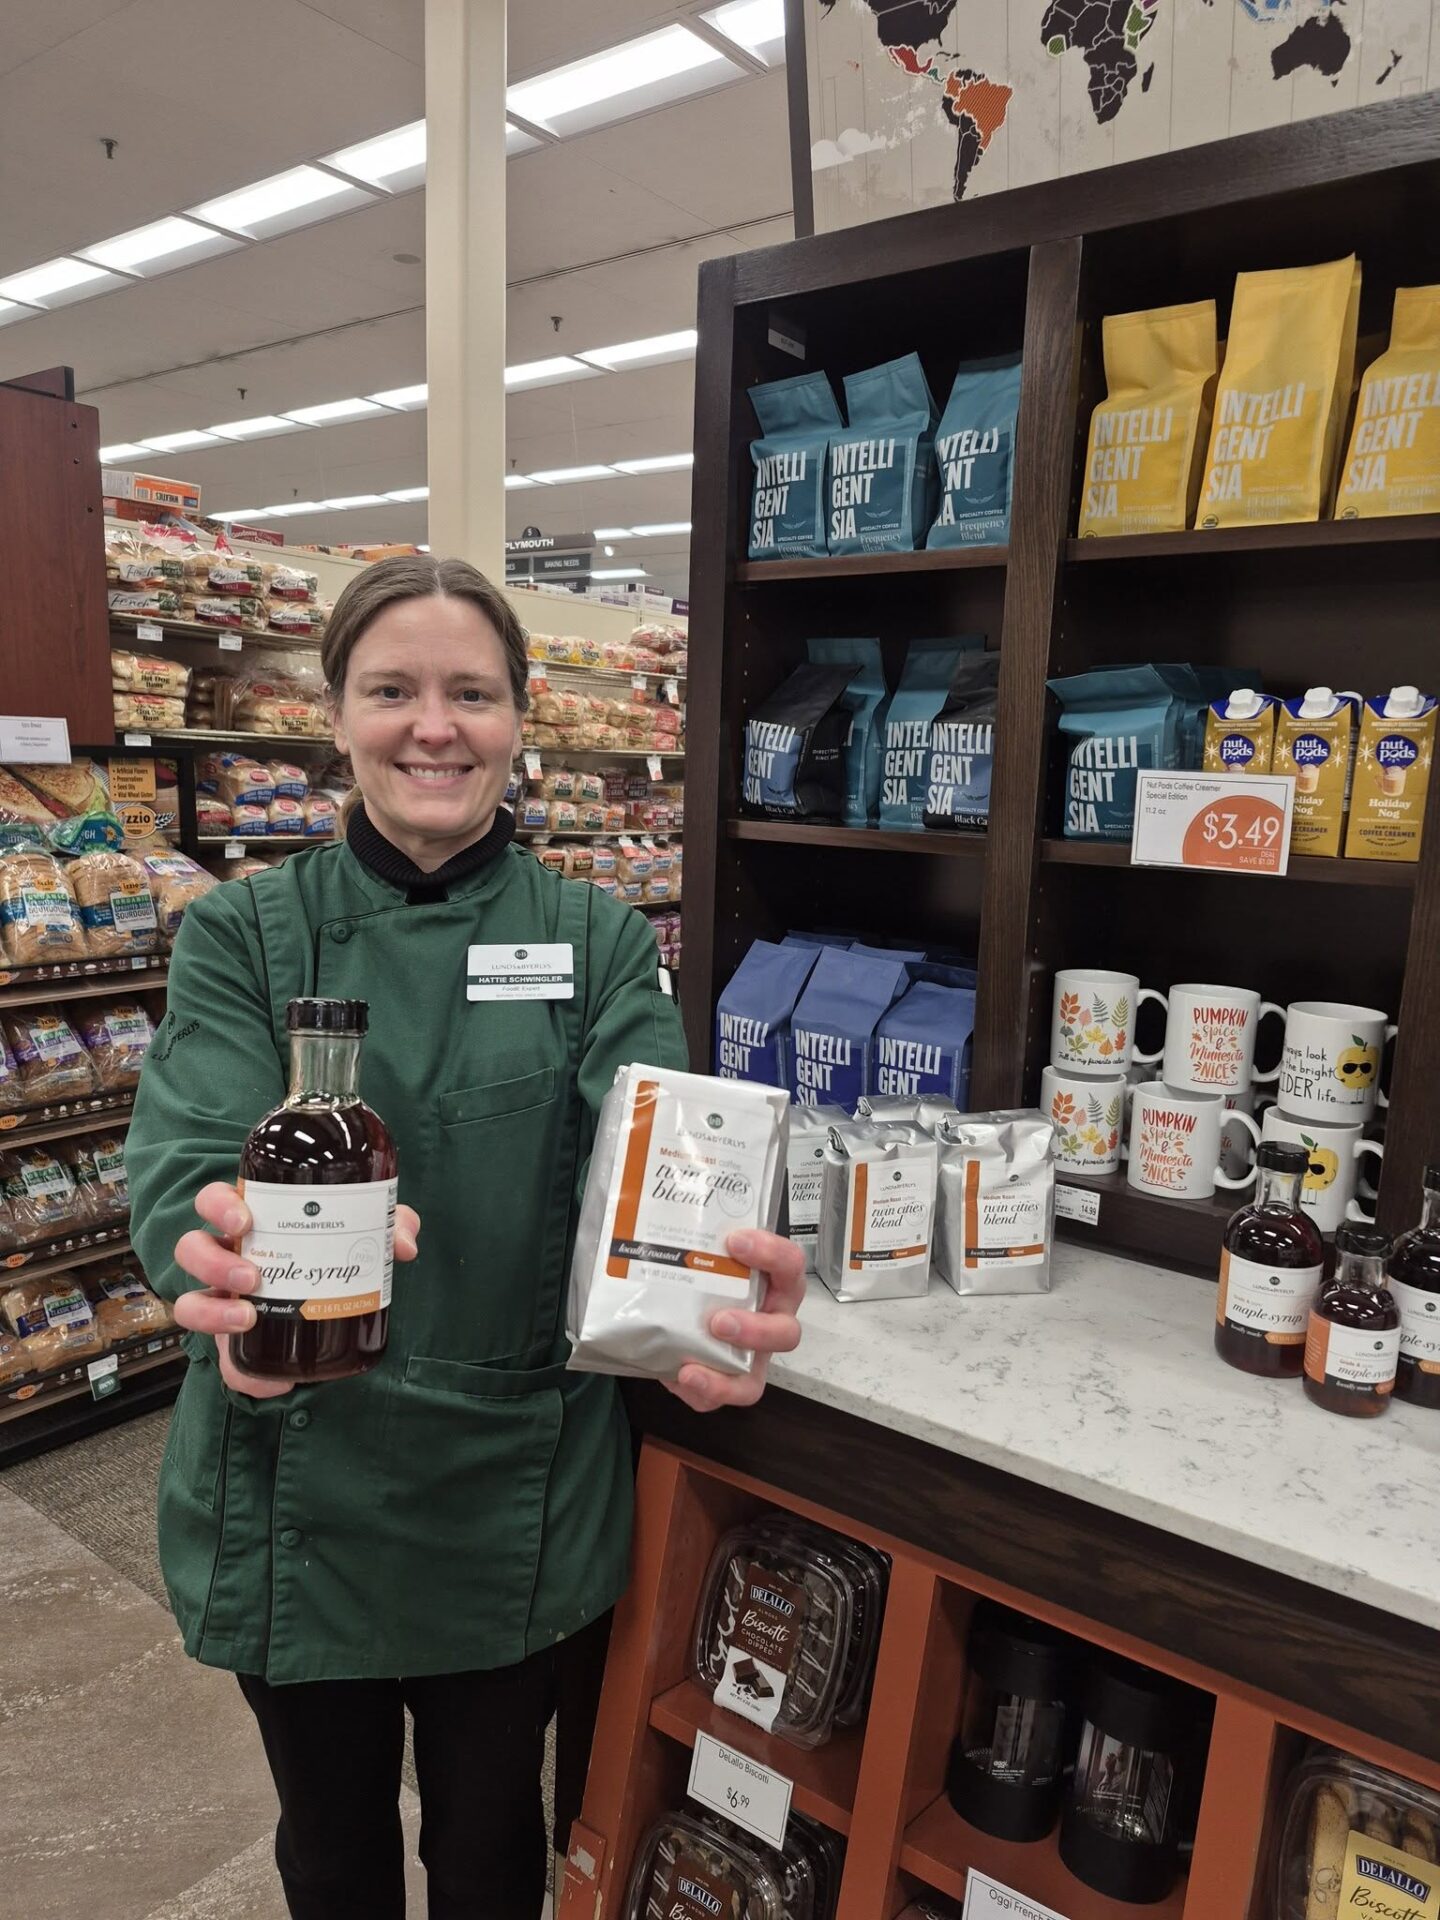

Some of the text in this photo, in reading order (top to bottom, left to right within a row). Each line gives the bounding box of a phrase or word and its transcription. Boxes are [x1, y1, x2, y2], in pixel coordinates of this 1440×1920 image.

[1219, 383, 1305, 425] INTELLI
[1094, 407, 1173, 447] INTELLI
[1355, 411, 1424, 455] GENT
[1214, 425, 1274, 464] GENT
[832, 438, 895, 476] INTELLI
[1090, 446, 1146, 483] GENT
[756, 451, 806, 488] INTELLI
[1344, 454, 1386, 496] SIA
[832, 472, 874, 509] GENT
[1206, 463, 1243, 503] SIA
[755, 485, 789, 519] GENT
[1085, 484, 1118, 520] SIA
[831, 508, 857, 541] SIA
[960, 511, 984, 519] SPECIALTY
[960, 519, 1005, 532] Frequency
[505, 538, 554, 550] PLYMOUTH
[752, 519, 774, 549] SIA
[860, 533, 901, 547] Frequency
[961, 531, 986, 541] Blend
[563, 559, 579, 567] NEEDS
[749, 719, 796, 754] INTELLI
[932, 722, 992, 755] INTELLI
[1223, 738, 1244, 748] nut
[1296, 738, 1318, 748] nut
[1380, 739, 1405, 750] nut
[748, 747, 775, 779] GENT
[884, 749, 926, 777] GENT
[1070, 736, 1138, 769] INTELLI
[1222, 744, 1253, 760] pods
[1295, 744, 1328, 760] pods
[1379, 745, 1416, 762] pods
[930, 753, 973, 786] GENT
[745, 776, 762, 805] SIA
[882, 778, 908, 806] SIA
[1069, 767, 1116, 802] GENT
[1147, 782, 1221, 792] Nut Pods Coffee Creamer
[926, 785, 954, 816] SIA
[1146, 792, 1188, 801] Special Edition
[1294, 796, 1325, 806] oliday
[1368, 798, 1412, 809] Holiday
[954, 815, 976, 824] Black
[1067, 800, 1100, 833] SIA
[1294, 806, 1313, 815] Nog
[1378, 809, 1400, 819] Nog
[1202, 810, 1280, 849] $3.49
[1384, 830, 1416, 838] CREAMER
[1239, 857, 1258, 865] SAVE
[479, 975, 563, 984] HATTIE SCHWINGLER
[1193, 1007, 1248, 1028] PUMPKIN
[719, 1012, 769, 1048] INTELLI
[719, 1039, 751, 1073] GENT
[795, 1028, 851, 1066] INTELLI
[878, 1036, 941, 1075] INTELLI
[1189, 1042, 1244, 1062] Minnesota
[1306, 1046, 1327, 1061] look
[796, 1057, 833, 1091] GENT
[878, 1066, 921, 1095] GENT
[1200, 1062, 1230, 1079] NICE
[1286, 1058, 1334, 1081] the bright
[796, 1084, 818, 1106] SIA
[1142, 1107, 1197, 1133] PUMPKIN
[1140, 1142, 1192, 1167] Minnesota
[705, 1170, 751, 1194] cities
[792, 1179, 816, 1190] twin
[1147, 1163, 1176, 1183] NICE
[652, 1179, 715, 1208] blend
[871, 1201, 923, 1217] twin cities
[983, 1200, 1040, 1213] twin cities
[1081, 1204, 1097, 1216] 14.99
[278, 1221, 345, 1229] LUNDS&BYERLYS
[870, 1215, 904, 1229] blend
[983, 1213, 1018, 1225] blend
[250, 1248, 267, 1258] Grade
[275, 1252, 293, 1260] pure
[618, 1243, 681, 1261] locally roasted
[304, 1264, 361, 1286] syrup
[270, 1304, 295, 1314] made
[307, 1305, 321, 1314] NET
[343, 1302, 353, 1311] OZ
[1232, 1303, 1303, 1326] maple syrup
[1337, 1366, 1372, 1379] maple
[752, 1587, 792, 1616] DELALLO
[741, 1609, 790, 1642] Biscotti
[741, 1628, 783, 1654] CHOCOLATE
[747, 1639, 773, 1656] DIPPED
[718, 1748, 770, 1784] DeLallo Biscotti
[727, 1786, 750, 1808] $6.99
[1361, 1859, 1425, 1898] DELALLO
[680, 1880, 719, 1913] DELALLO
[989, 1888, 1044, 1920] Oggi French
